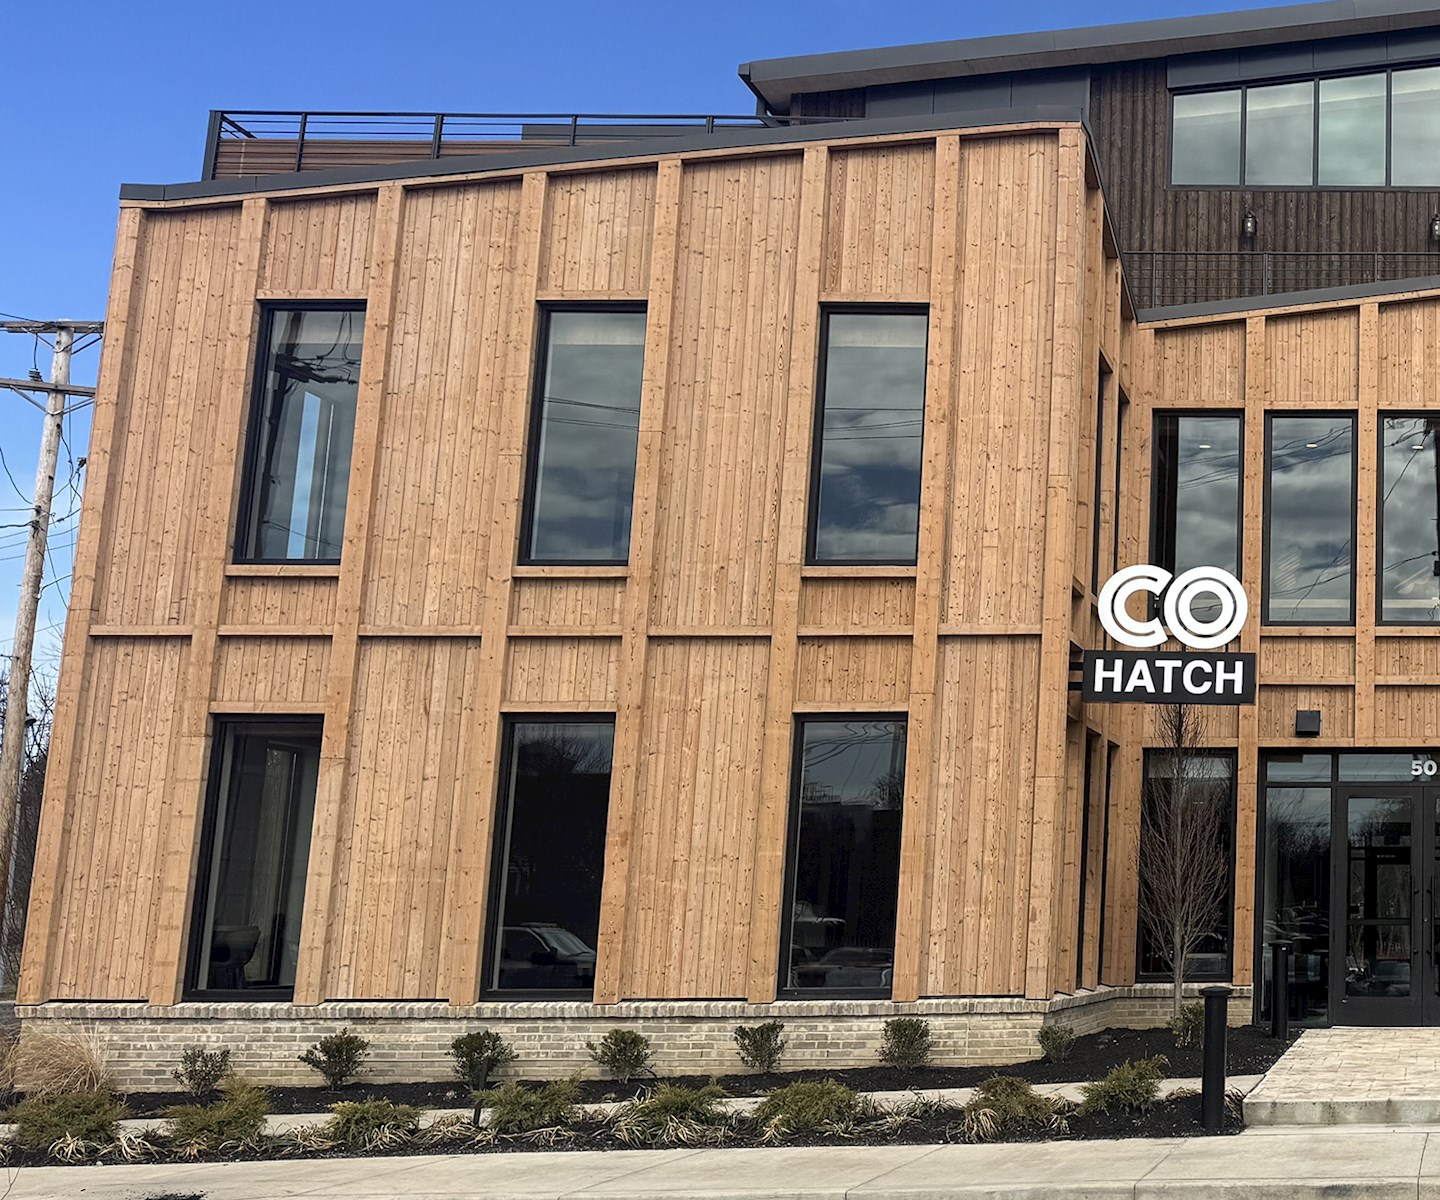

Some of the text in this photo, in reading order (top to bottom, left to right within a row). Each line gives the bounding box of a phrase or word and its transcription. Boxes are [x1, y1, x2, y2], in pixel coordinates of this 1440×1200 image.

[1097, 564, 1248, 649] CO
[1093, 658, 1244, 695] HATCH
[1411, 760, 1437, 776] 50
